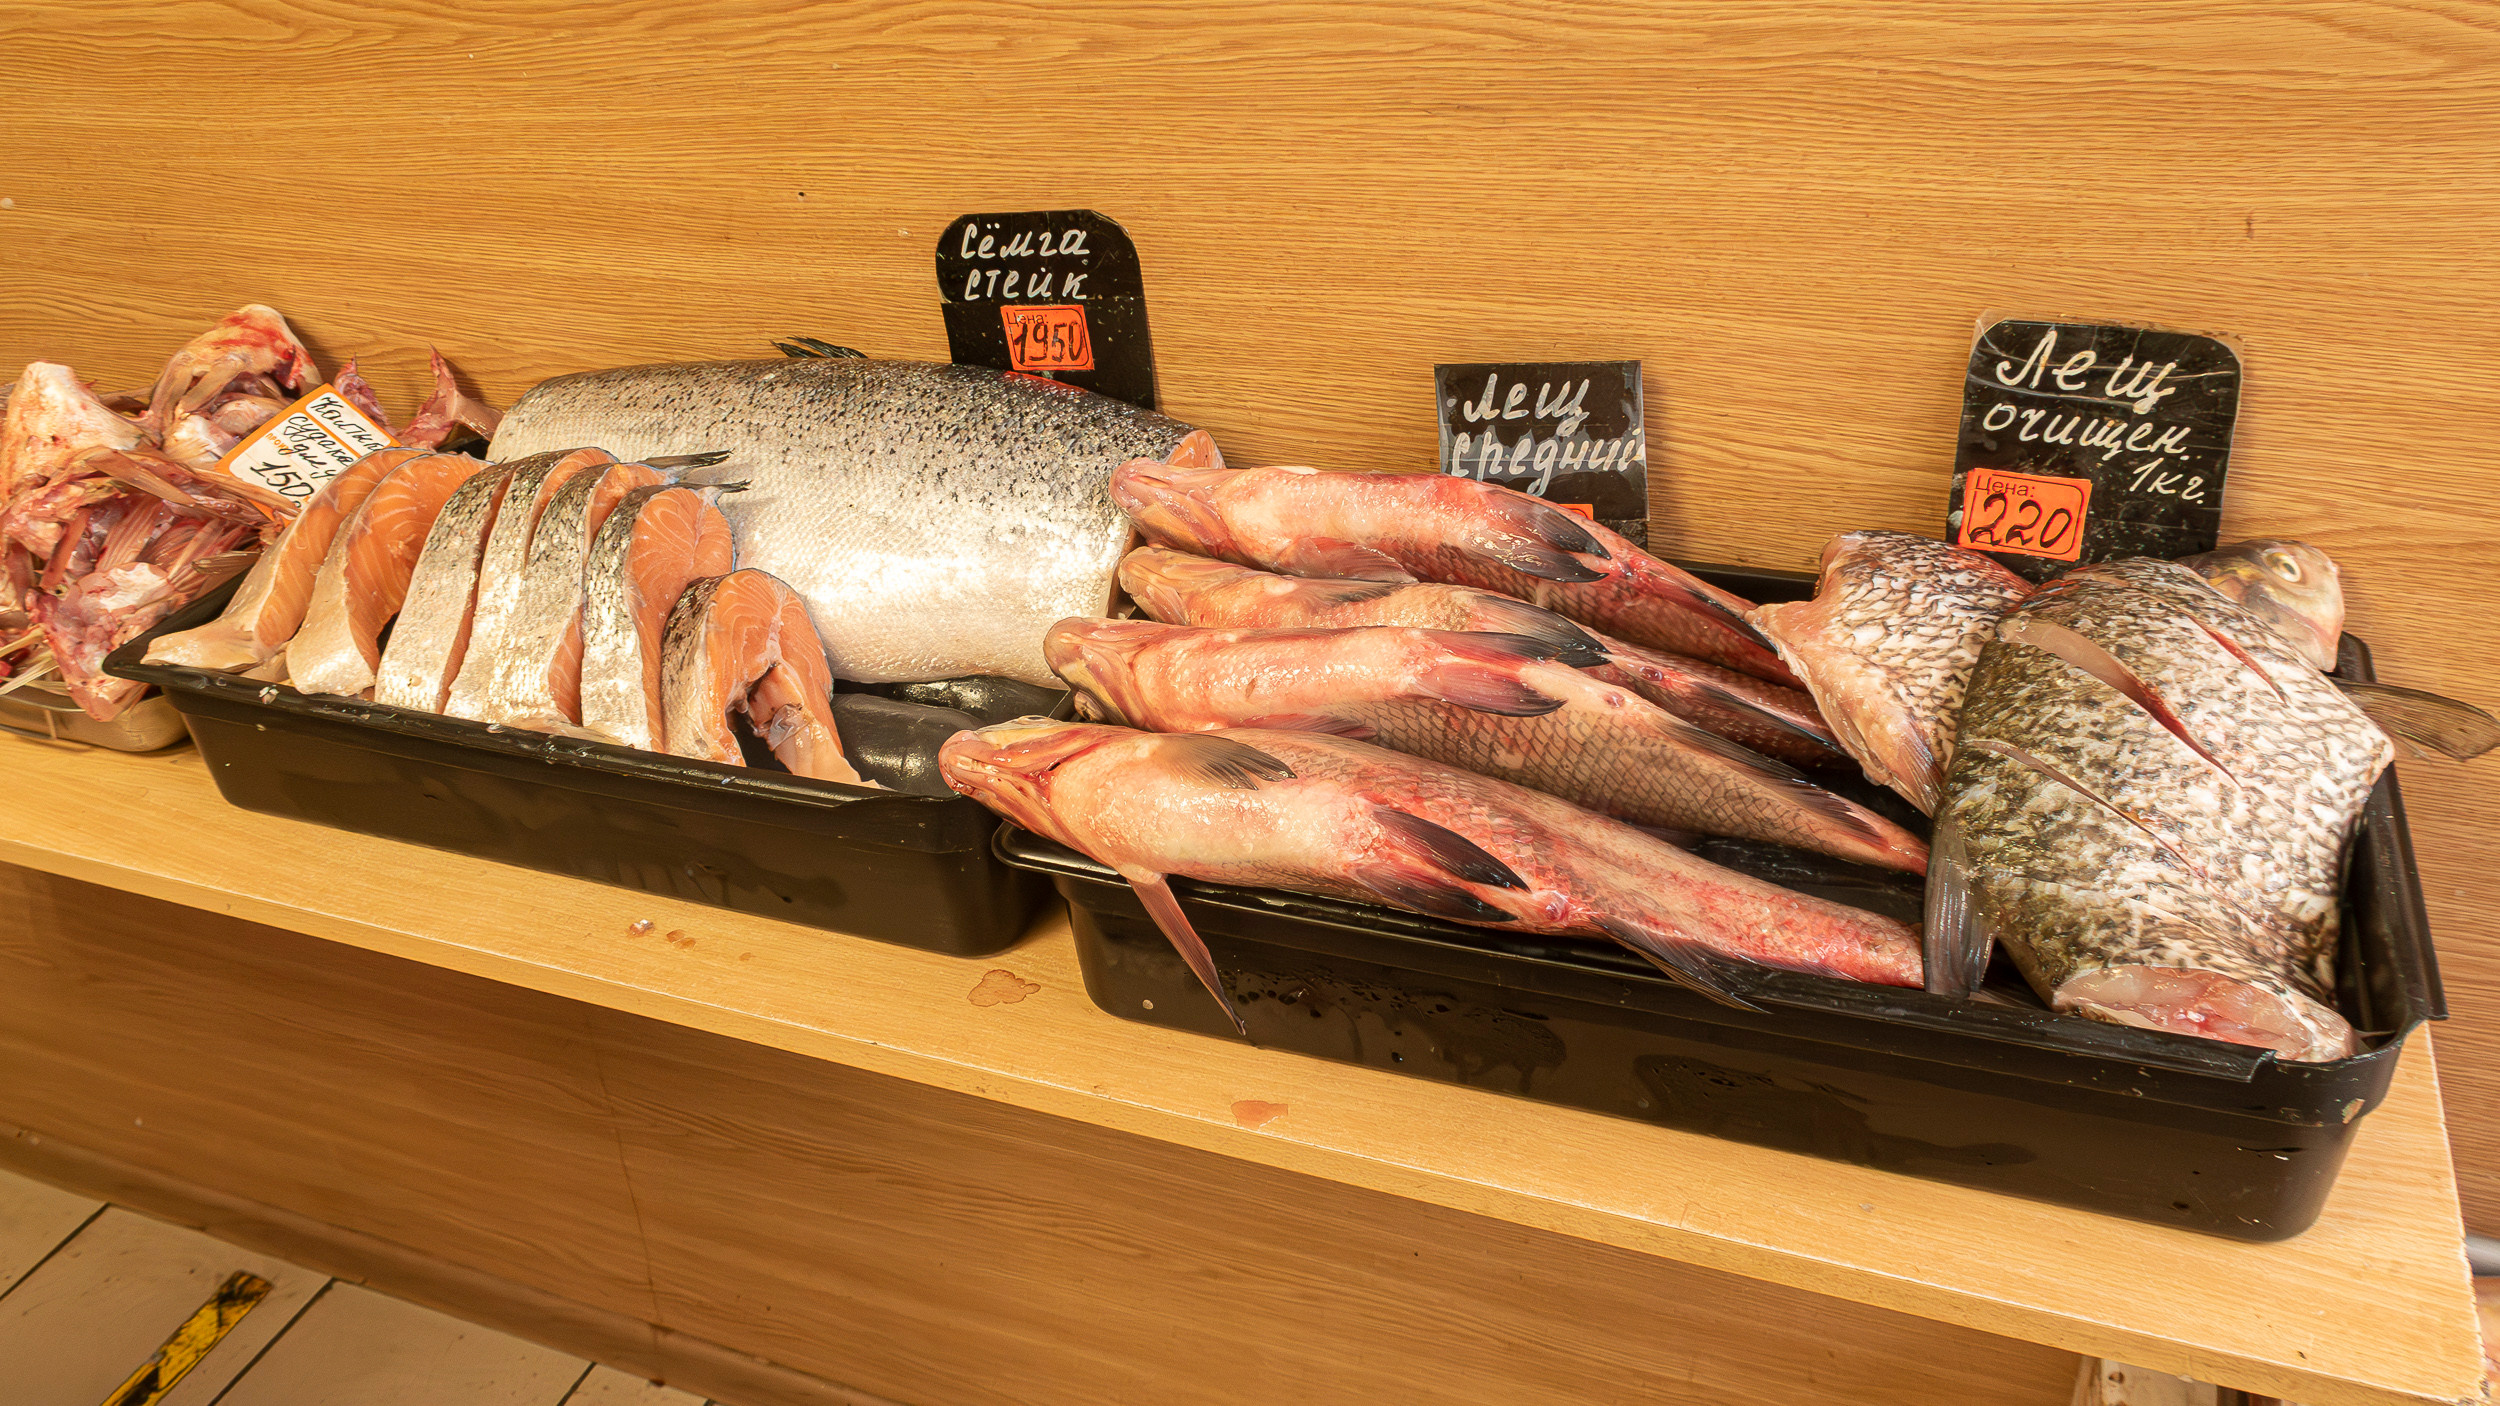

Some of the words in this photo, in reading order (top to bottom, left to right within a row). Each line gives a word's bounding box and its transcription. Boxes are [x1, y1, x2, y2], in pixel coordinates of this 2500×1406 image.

[961, 223, 1090, 259] Сёмга
[1013, 320, 1084, 365] 1950
[1996, 330, 2177, 414] Лещ
[250, 461, 315, 497] 150
[310, 468, 338, 481] у
[1975, 475, 2037, 498] Цена:
[1968, 492, 2073, 549] 220
